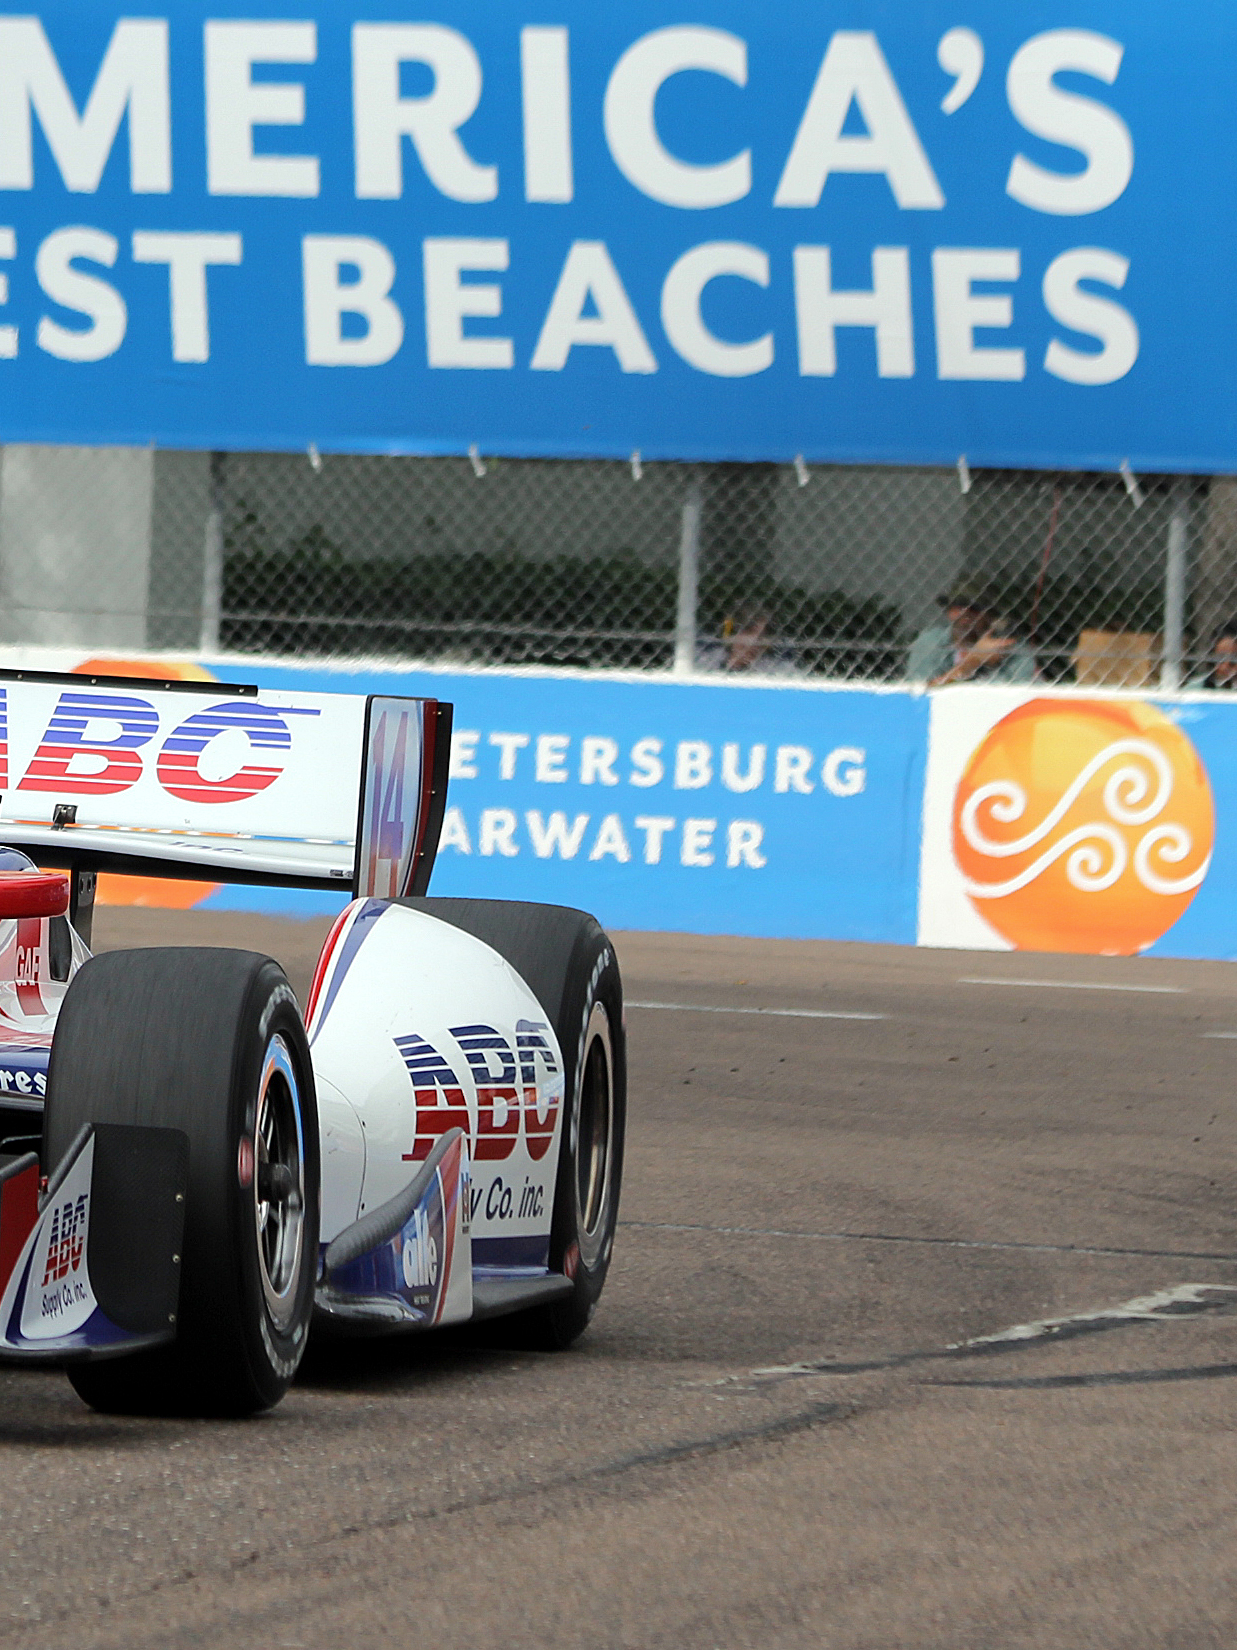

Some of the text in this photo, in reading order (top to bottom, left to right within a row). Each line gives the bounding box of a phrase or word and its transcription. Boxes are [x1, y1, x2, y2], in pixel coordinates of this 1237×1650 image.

[301, 233, 1140, 386] BEACHES
[392, 1018, 560, 1162] ABC
[41, 1194, 89, 1288] ABC
[485, 1176, 514, 1221] Co.
[518, 1175, 544, 1219] inc.
